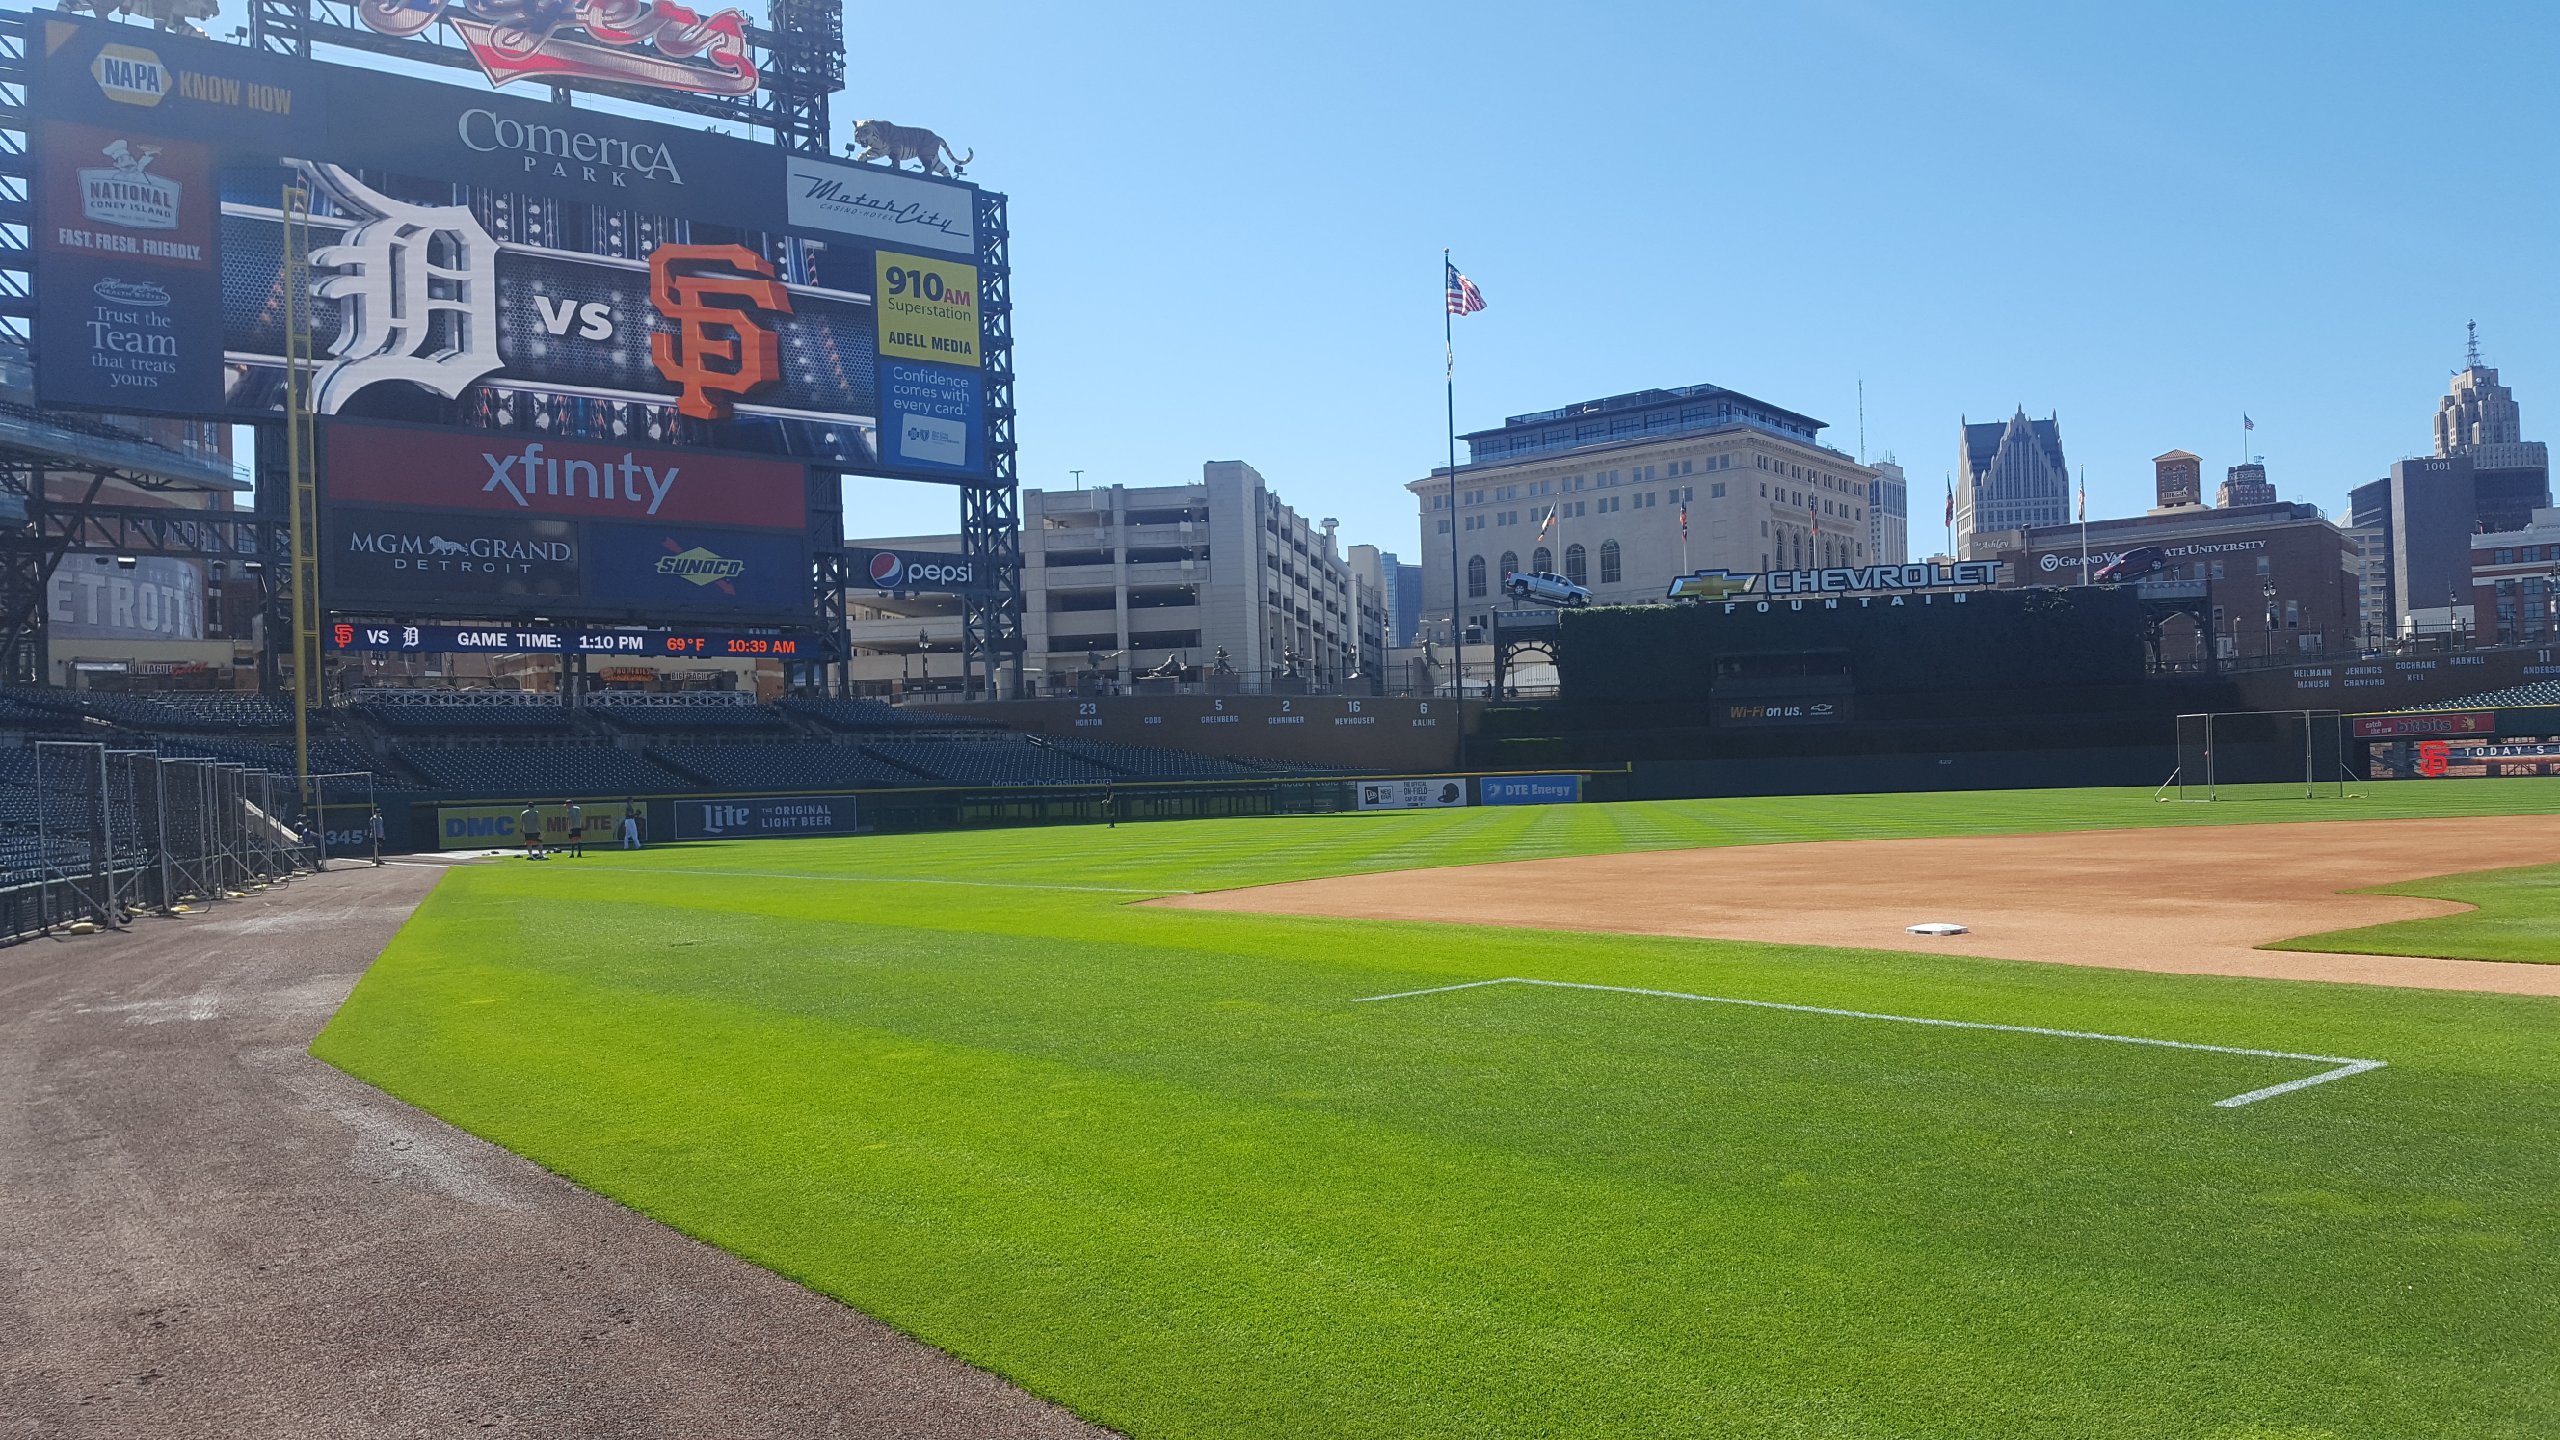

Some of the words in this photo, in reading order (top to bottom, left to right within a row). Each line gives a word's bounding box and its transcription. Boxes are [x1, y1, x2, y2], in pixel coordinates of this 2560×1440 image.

[104, 58, 160, 93] NAPA
[179, 70, 240, 106] KNOW
[248, 82, 292, 115] HOW
[524, 156, 627, 188] PARK
[90, 181, 173, 209] NATIONAL
[90, 200, 126, 209] CONEY
[130, 203, 171, 218] ISLAND
[59, 228, 94, 248] FAST.
[95, 233, 140, 253] FRESH.
[143, 239, 202, 260] FRIENDLY.
[94, 306, 140, 324] Trust
[145, 311, 171, 328] the
[533, 295, 614, 341] VS
[888, 297, 972, 322] Superstation
[86, 320, 178, 356] Team
[889, 331, 927, 348] ADELL
[931, 336, 972, 354] MEDIA
[92, 353, 124, 369] that
[131, 358, 176, 374] treats
[110, 373, 158, 388] yours
[893, 366, 969, 388] Confidence
[893, 385, 937, 398] comes
[941, 388, 969, 402] with
[893, 399, 931, 414] every
[935, 403, 967, 416] card.
[2424, 462, 2451, 471] 1001
[481, 443, 680, 515] xfinity
[350, 531, 423, 555] MGM
[469, 538, 572, 562] GRAND
[1981, 539, 2009, 551] Ashley
[2059, 555, 2103, 567] GRAND
[2187, 540, 2267, 555] UNIVERSITY
[394, 558, 532, 574] DETROIT
[657, 556, 742, 577] SUNOCO
[908, 562, 973, 585] pepsi
[1766, 559, 2004, 595] CHEVROLET
[1724, 592, 1967, 615] FOUNTAIN
[366, 629, 390, 644] VS
[457, 632, 508, 648] GAME
[516, 633, 562, 648] TIME:
[579, 635, 614, 649] 1:10
[618, 636, 644, 650] PM
[728, 639, 768, 653] 10:39
[772, 640, 796, 653] AM
[2395, 660, 2437, 670] COCHRANE
[2537, 650, 2551, 663] 11
[2345, 666, 2383, 675] JENNINGS
[2297, 679, 2330, 689] MANUSH
[1079, 703, 1097, 715] 23
[1215, 699, 1223, 711] 5
[1282, 700, 1291, 712] 2
[1347, 701, 1361, 713] 16
[1419, 702, 1428, 714] 6
[1730, 705, 1765, 718] Wi-Fi
[1766, 707, 1781, 717] on
[1784, 706, 1803, 716] us.
[1201, 715, 1239, 724] GREENBERG
[2365, 721, 2382, 729] catch
[2464, 745, 2545, 757] TODAY'S
[1505, 784, 1529, 796] DTE
[1531, 783, 1570, 797] Energy
[702, 804, 750, 833] Lite
[775, 804, 832, 815] ORIGINAL
[446, 815, 515, 838] DMC
[761, 816, 798, 828] LIGHT
[801, 815, 832, 826] BEER
